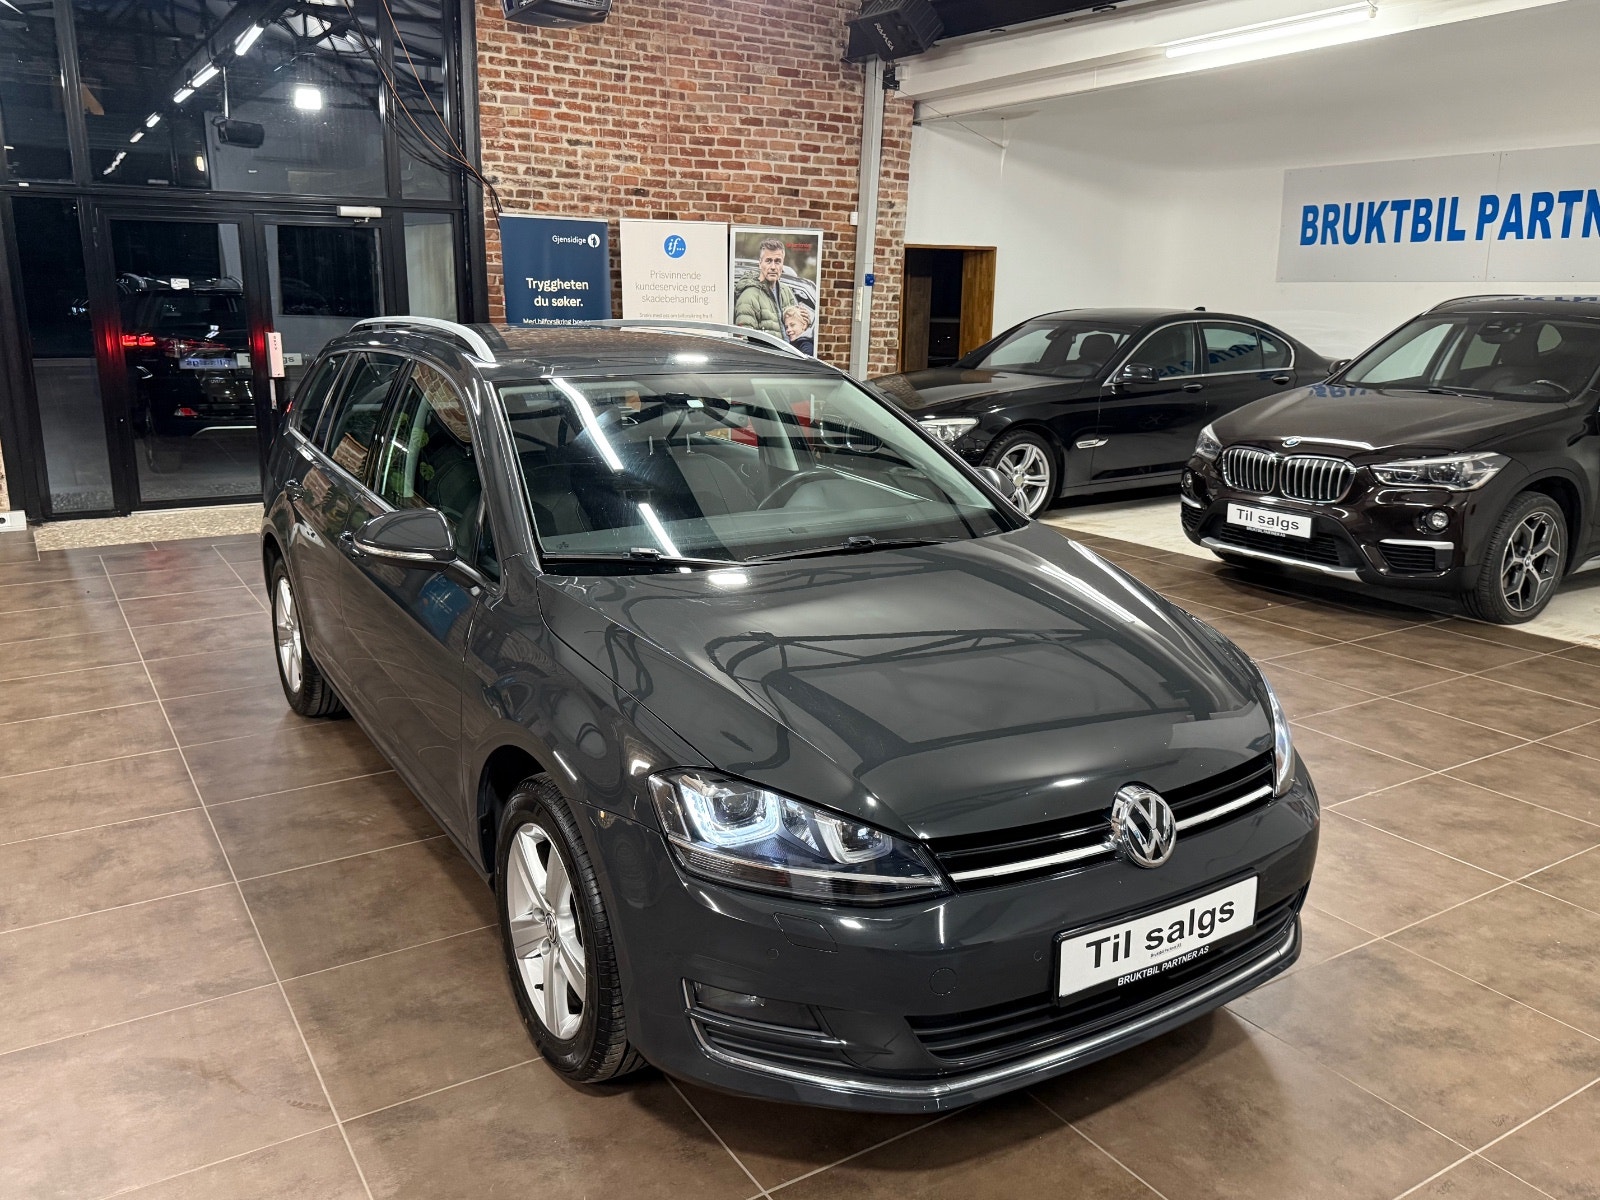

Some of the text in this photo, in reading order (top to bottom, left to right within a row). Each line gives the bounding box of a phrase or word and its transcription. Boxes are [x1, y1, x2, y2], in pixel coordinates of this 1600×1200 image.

[1299, 188, 1600, 246] BRUKTBIL PARTN
[551, 234, 587, 246] Gjensidige
[650, 269, 702, 280] Prisvinnende
[525, 277, 589, 292] Tryggheten
[635, 282, 716, 294] kundeservice og god
[534, 295, 584, 307] du søker.
[1236, 508, 1300, 531] Til salgs
[1085, 900, 1235, 969] Til salgs
[1117, 945, 1210, 987] BRUKTBIL PARTNER AS
